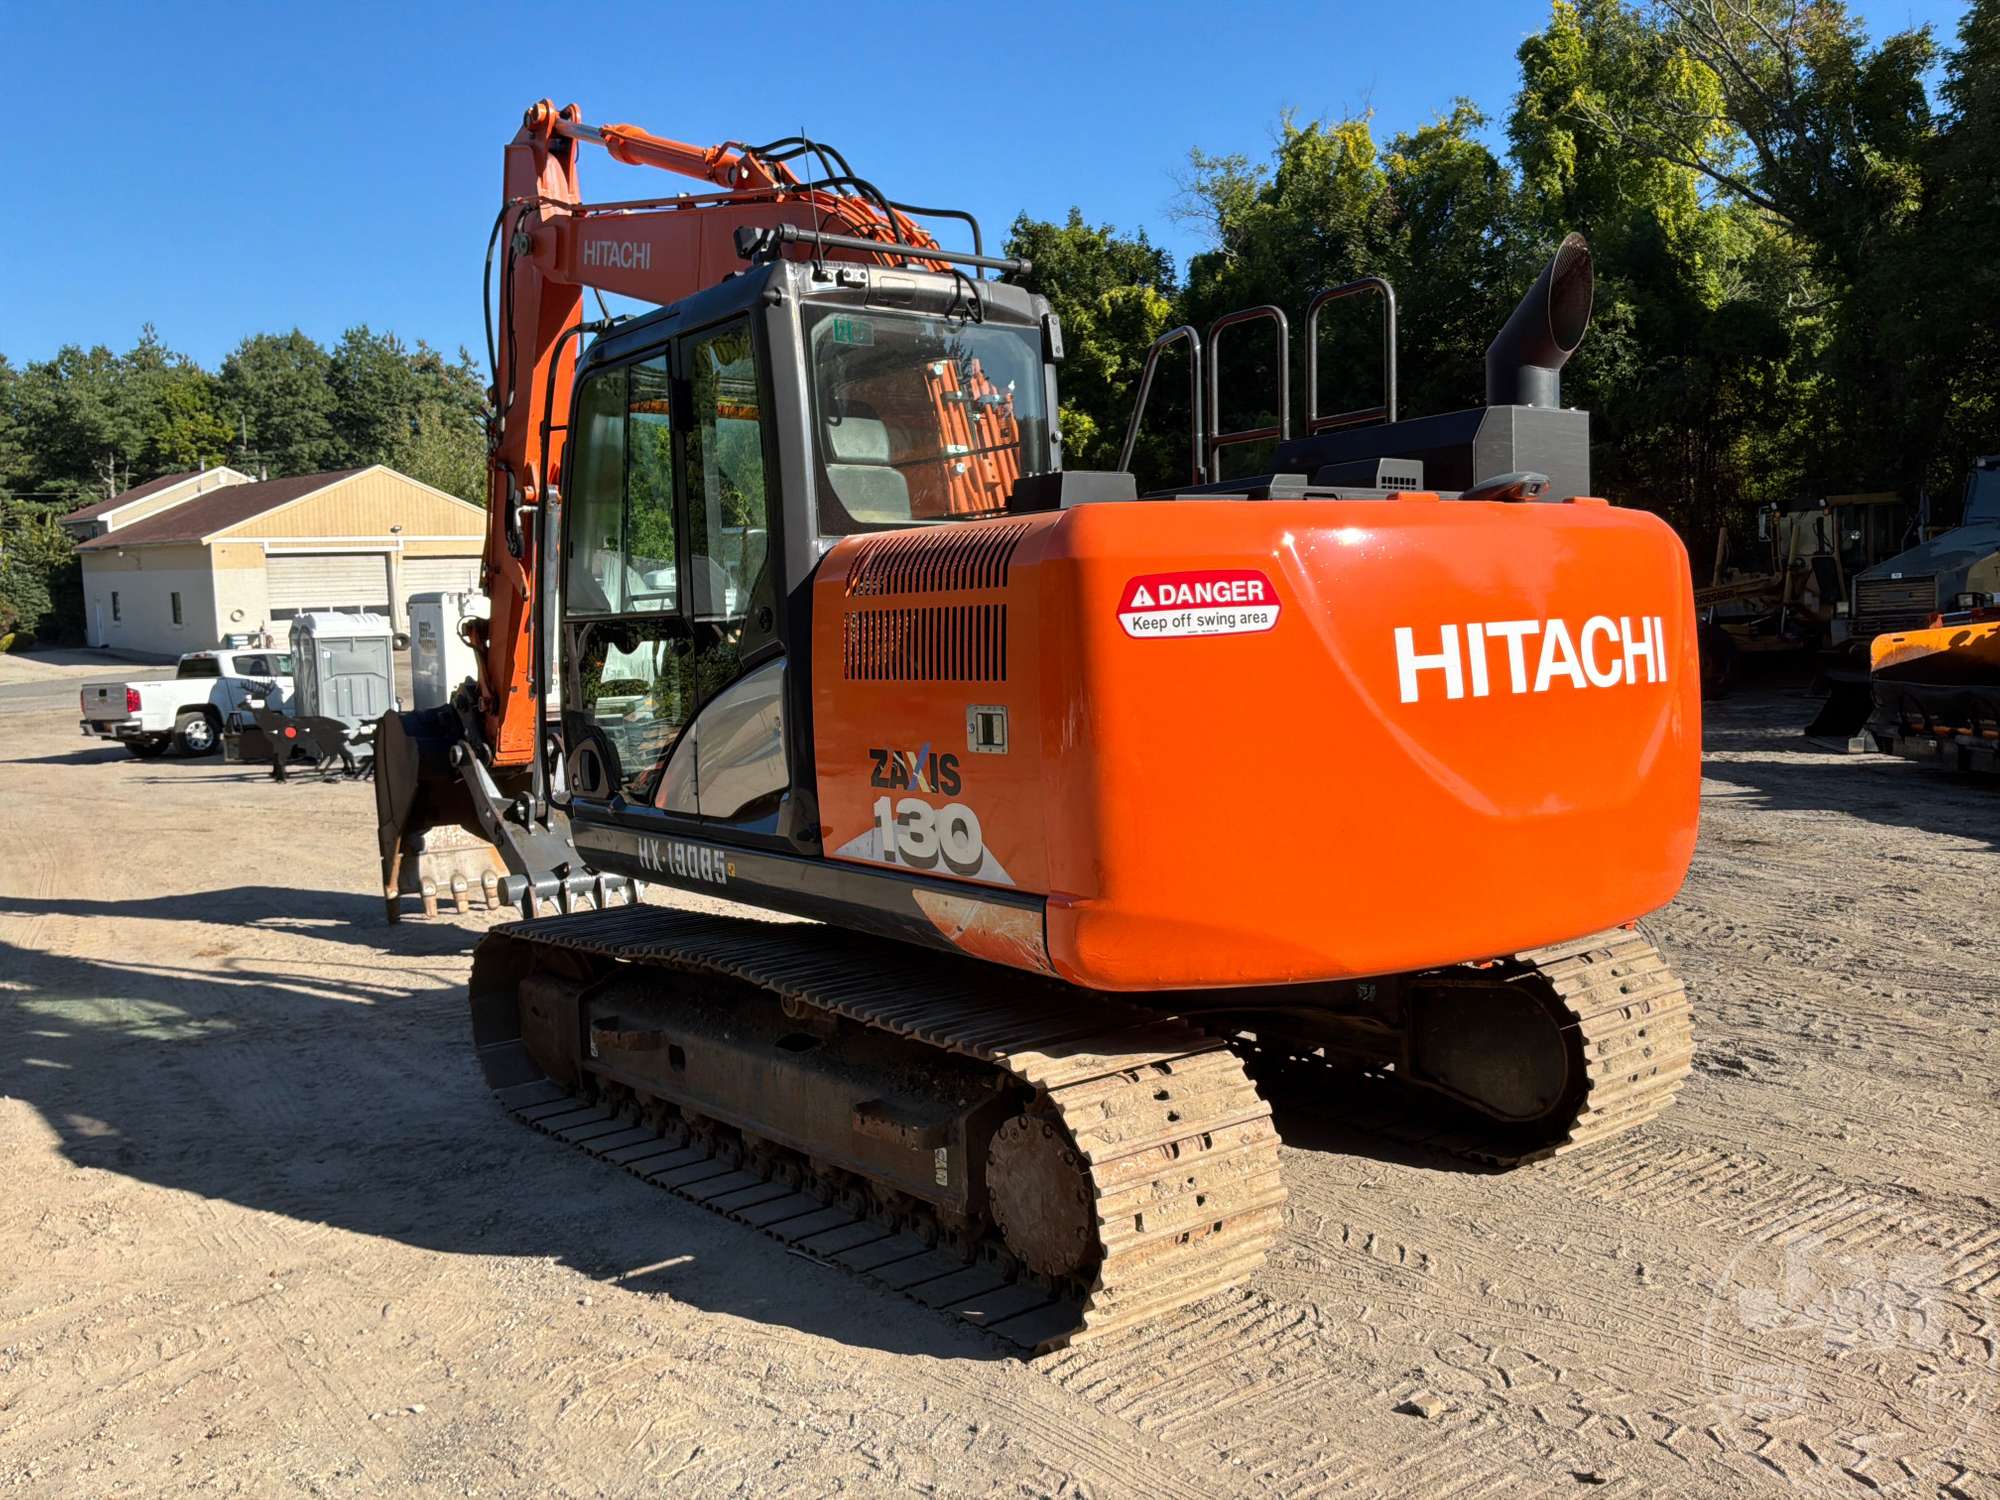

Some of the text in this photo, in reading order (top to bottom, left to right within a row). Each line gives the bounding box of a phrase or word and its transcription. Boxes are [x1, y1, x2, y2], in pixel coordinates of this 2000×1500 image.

[583, 239, 651, 270] HITACHI
[1158, 580, 1264, 605] DANGER
[1132, 611, 1268, 632] Keep off swing area
[1394, 615, 1668, 704] HITACHI
[868, 741, 962, 796] ZAXIS
[873, 796, 984, 876] 130
